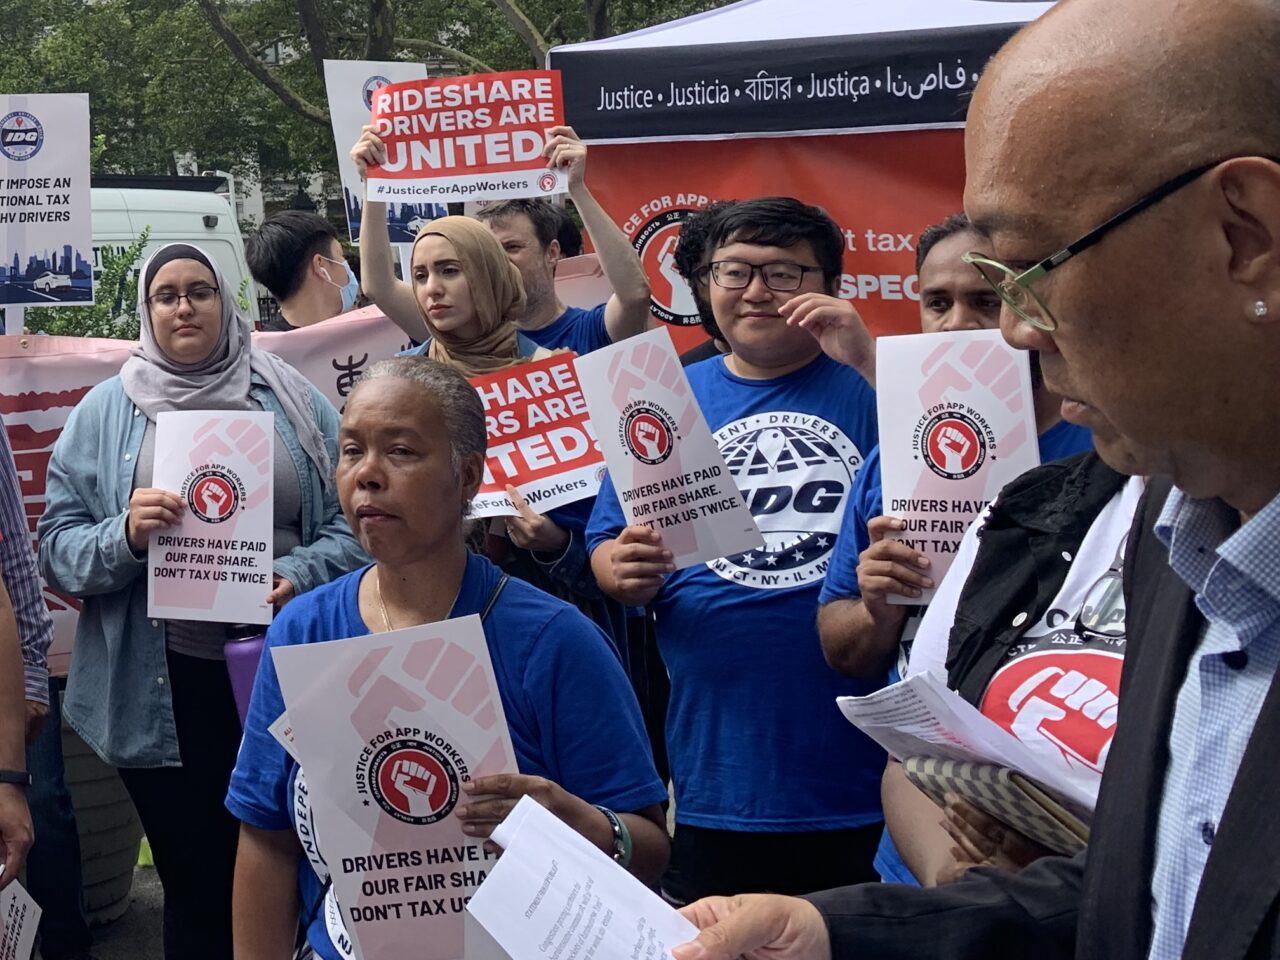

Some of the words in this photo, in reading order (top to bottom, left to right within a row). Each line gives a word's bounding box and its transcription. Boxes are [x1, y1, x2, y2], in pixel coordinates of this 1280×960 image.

[376, 77, 553, 116] RIDESHARE
[596, 85, 654, 111] Justice
[667, 79, 730, 107] Justicia
[807, 71, 870, 103] Justiça
[376, 107, 493, 137] DRIVERS
[498, 102, 555, 127] ARE
[5, 131, 38, 142] IDG
[6, 177, 50, 190] IMPOSE
[53, 177, 71, 189] AN
[377, 178, 529, 196] #JusticeForAppWorkers
[46, 194, 70, 205] TAX
[640, 195, 673, 218] FOR
[675, 193, 709, 208] APP
[19, 211, 71, 223] DRIVERS
[865, 229, 914, 252] tax
[527, 392, 588, 429] ARE
[622, 403, 634, 417] FOR
[648, 400, 679, 432] WORKERS
[618, 415, 627, 448] JUSTICE
[769, 414, 839, 441] DRIVERS
[912, 413, 929, 451] JUSTICE
[927, 403, 945, 417] FOR
[946, 402, 965, 410] APP
[966, 406, 997, 450] WORKERS
[180, 471, 197, 500] JUSTICE
[195, 463, 210, 474] FOR
[210, 463, 226, 471] APP
[226, 468, 247, 502] WORKERS
[621, 481, 661, 504] DRIVERS
[662, 473, 692, 493] HAVE
[695, 465, 721, 486] PAID
[632, 502, 652, 518] OUR
[652, 495, 677, 514] FAIR
[679, 483, 722, 508] SHARE.
[657, 512, 682, 531] TAX
[683, 508, 699, 522] US
[701, 496, 741, 519] TWICE.
[891, 499, 948, 513] DRIVERS
[931, 520, 964, 533] FAIR
[157, 535, 205, 549] DRIVERS
[207, 538, 236, 551] HAVE
[239, 540, 267, 552] PAID
[165, 552, 188, 564] OUR
[190, 553, 215, 565] FAIR
[216, 555, 258, 568] SHARE.
[713, 558, 727, 573] NJ
[733, 570, 749, 582] CT
[761, 574, 780, 585] NY
[793, 571, 806, 582] IL
[154, 566, 187, 579] DON'T
[189, 568, 210, 581] TAX
[212, 570, 228, 582] US
[230, 571, 269, 585] TWICE.
[355, 746, 373, 795] JUSTICE
[370, 730, 394, 749] FOR
[395, 727, 421, 738] APP
[424, 730, 472, 783] WORKERS
[342, 850, 423, 874] DRIVERS
[426, 845, 480, 866] HAVE
[362, 878, 399, 897] OUR
[404, 875, 448, 894] FAIR
[350, 902, 403, 923] DON'T
[407, 899, 446, 918] TAX
[338, 933, 353, 956] NJ
